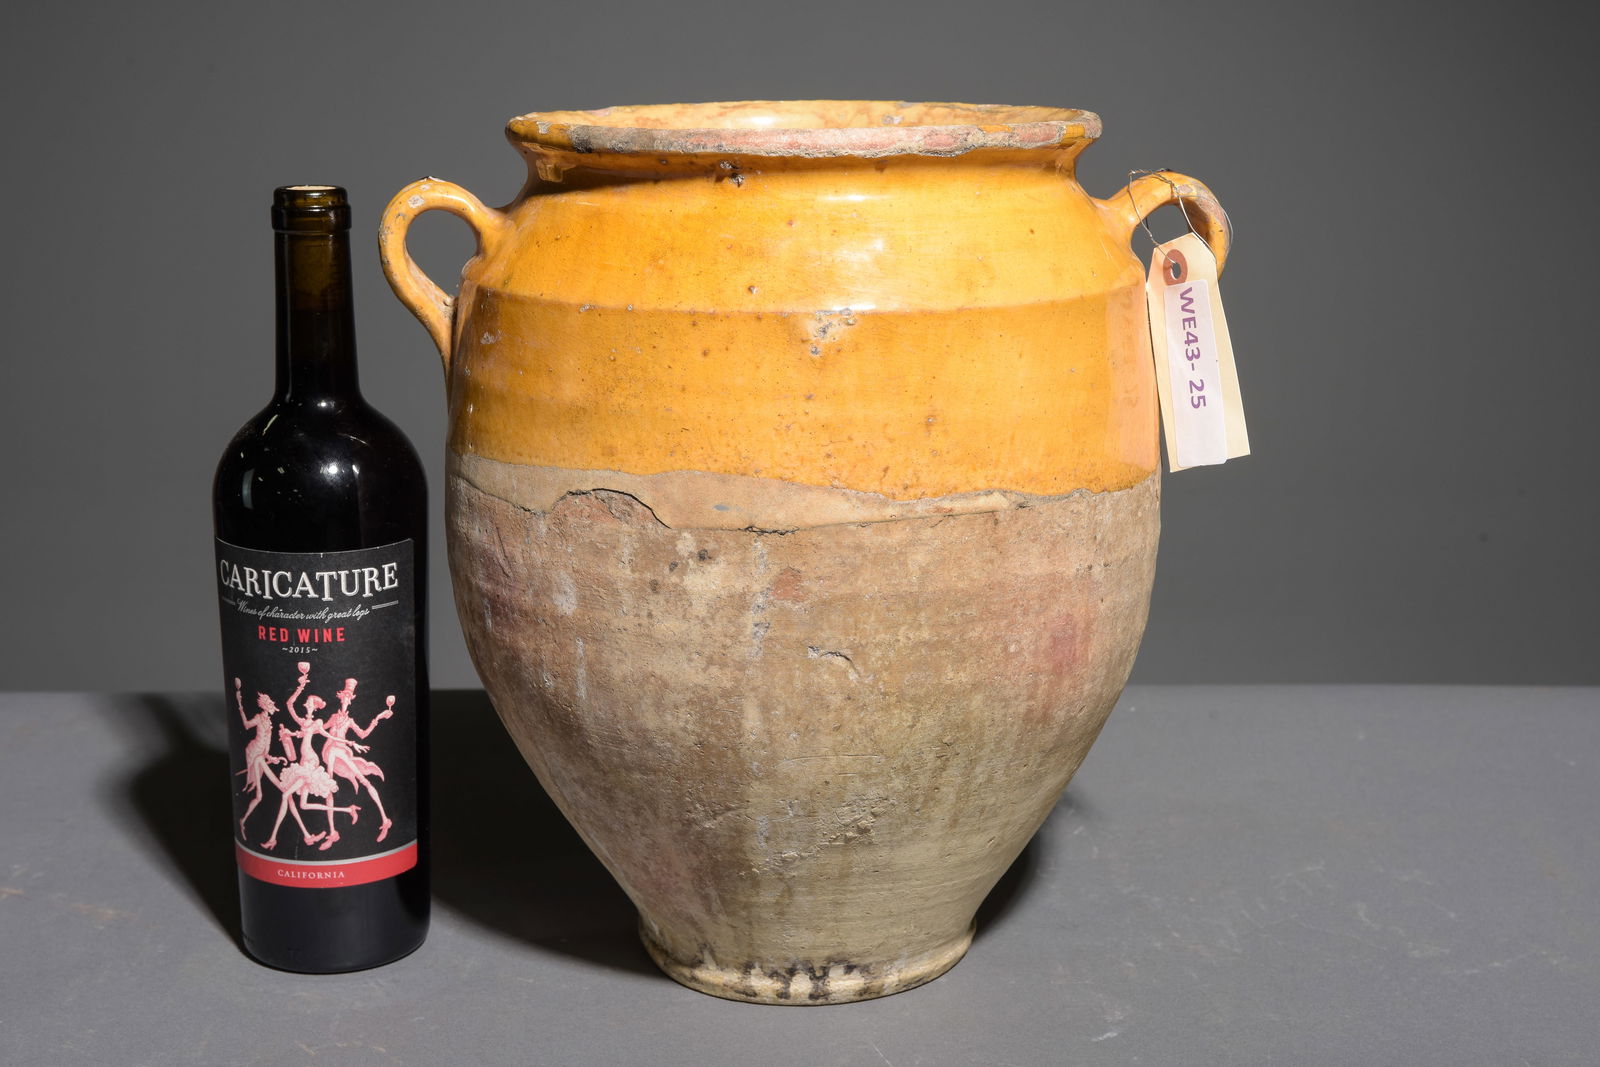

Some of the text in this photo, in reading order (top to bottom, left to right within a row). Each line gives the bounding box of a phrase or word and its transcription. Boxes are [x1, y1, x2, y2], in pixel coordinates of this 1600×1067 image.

[220, 559, 399, 602] CARICATURE
[236, 598, 370, 624] Wines of character with great legs
[258, 625, 346, 643] RED WINE
[277, 869, 345, 879] CALIFORNIA
